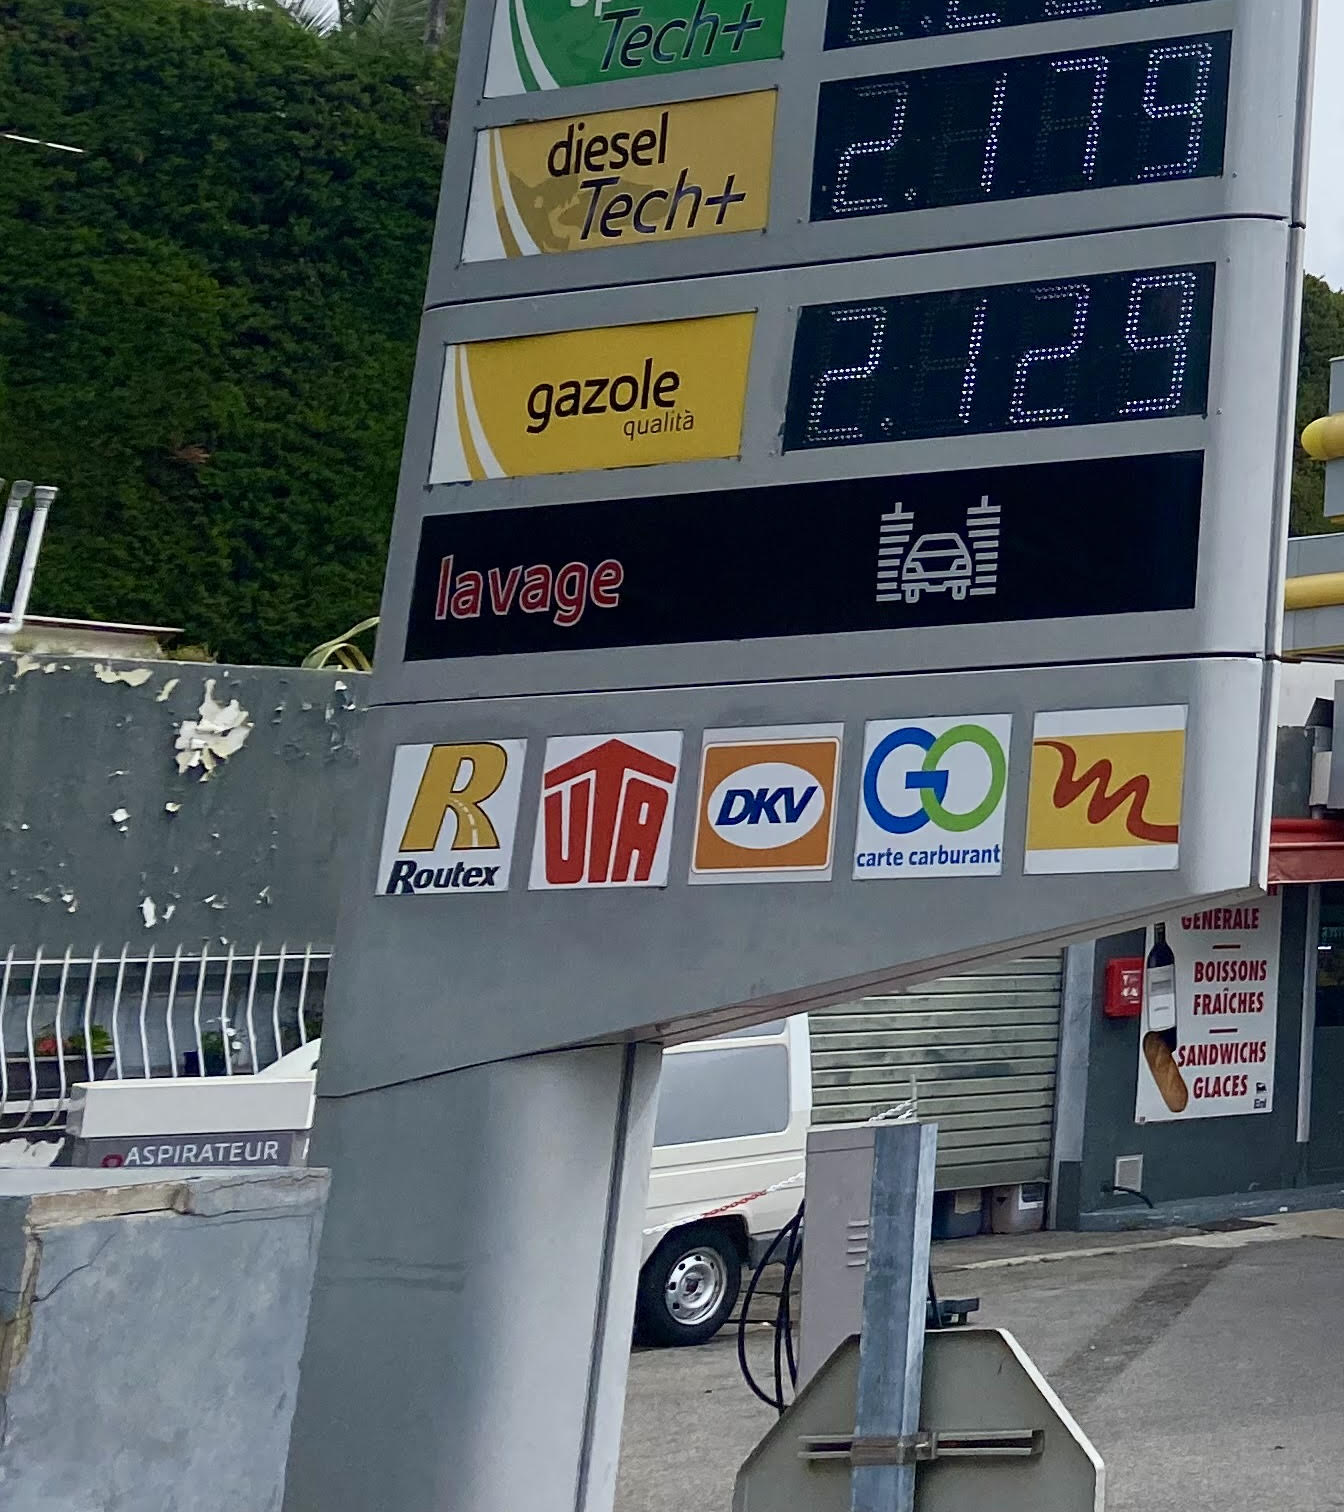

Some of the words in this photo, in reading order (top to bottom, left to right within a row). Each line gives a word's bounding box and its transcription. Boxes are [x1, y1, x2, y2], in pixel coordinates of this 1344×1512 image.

[546, 112, 670, 179] diesel
[830, 40, 1214, 215] 2.179
[579, 170, 747, 241] Tech+
[805, 270, 1197, 442] 2.129
[525, 356, 681, 434] gazole
[623, 408, 696, 442] qualità
[434, 554, 624, 627] lavage
[863, 723, 1008, 835] GO
[543, 738, 678, 885] UTA
[715, 785, 820, 827] DKV
[384, 858, 501, 896] Routex
[856, 848, 905, 869] carte
[908, 843, 1002, 868] carburant
[1193, 959, 1268, 983] BOISSONS
[1193, 988, 1265, 1017] FRAÎCHES
[1177, 1040, 1267, 1068] SANDWICHS
[1192, 1074, 1249, 1100] GLACES
[124, 1140, 280, 1167] ASPIRATEUR
